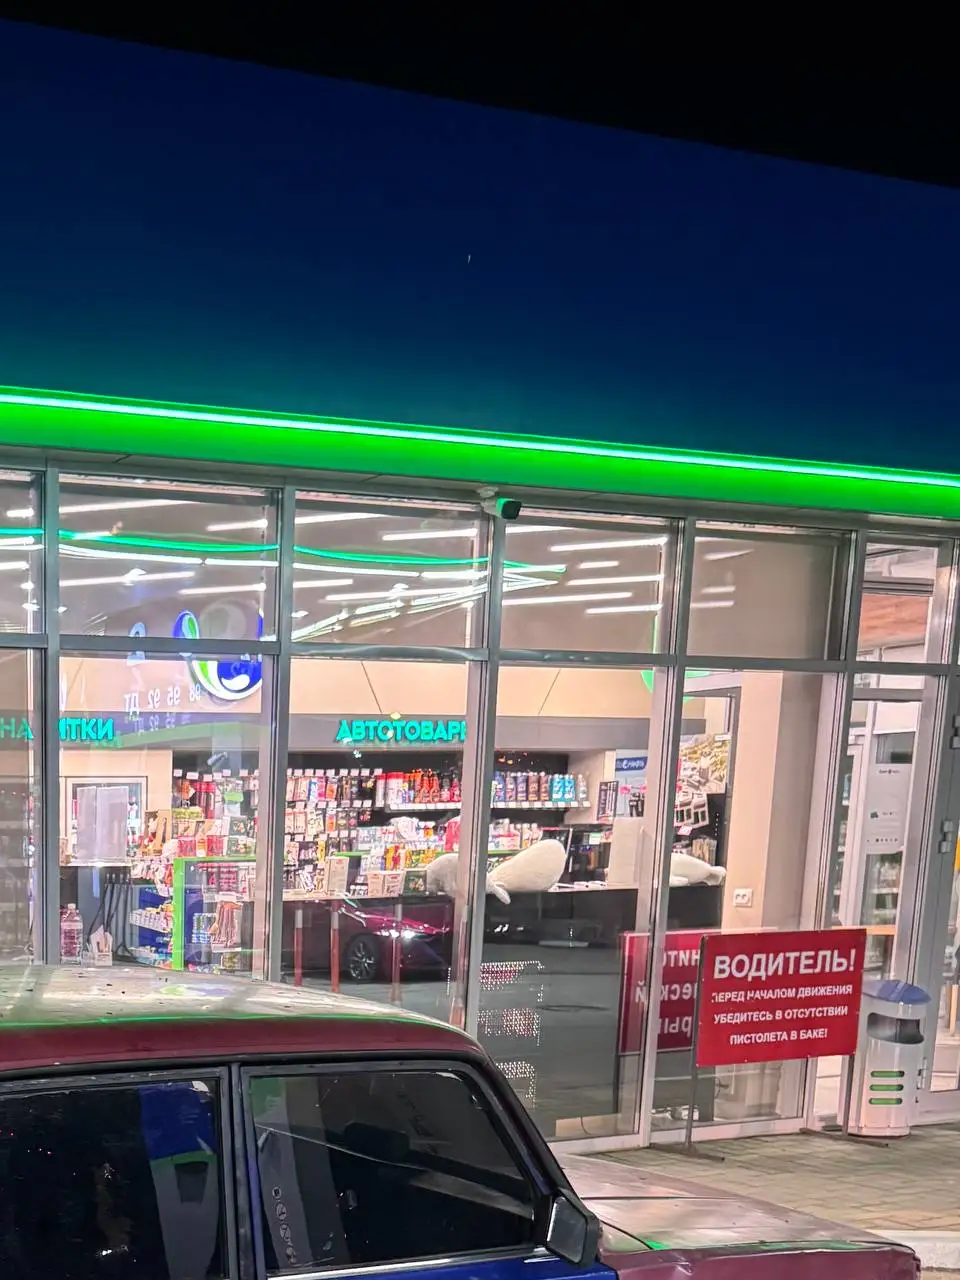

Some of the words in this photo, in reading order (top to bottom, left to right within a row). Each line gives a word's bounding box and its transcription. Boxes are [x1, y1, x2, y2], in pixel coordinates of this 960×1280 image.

[0, 717, 114, 741] НАТКИ
[713, 948, 857, 981] ВОДИТЕЛЬ!
[746, 988, 796, 1001] НАЧАЛОМ
[797, 984, 853, 999] ДВИЖЕНИЯ
[713, 1010, 773, 1025] УБЕДИТЕСЬ
[775, 1009, 782, 1021] В
[784, 1005, 848, 1020] ОТСУТСТВИИ
[729, 1031, 789, 1045] ПИСТОЛЕТА
[790, 1030, 797, 1041] В
[800, 1028, 828, 1039] БАКЕ!
